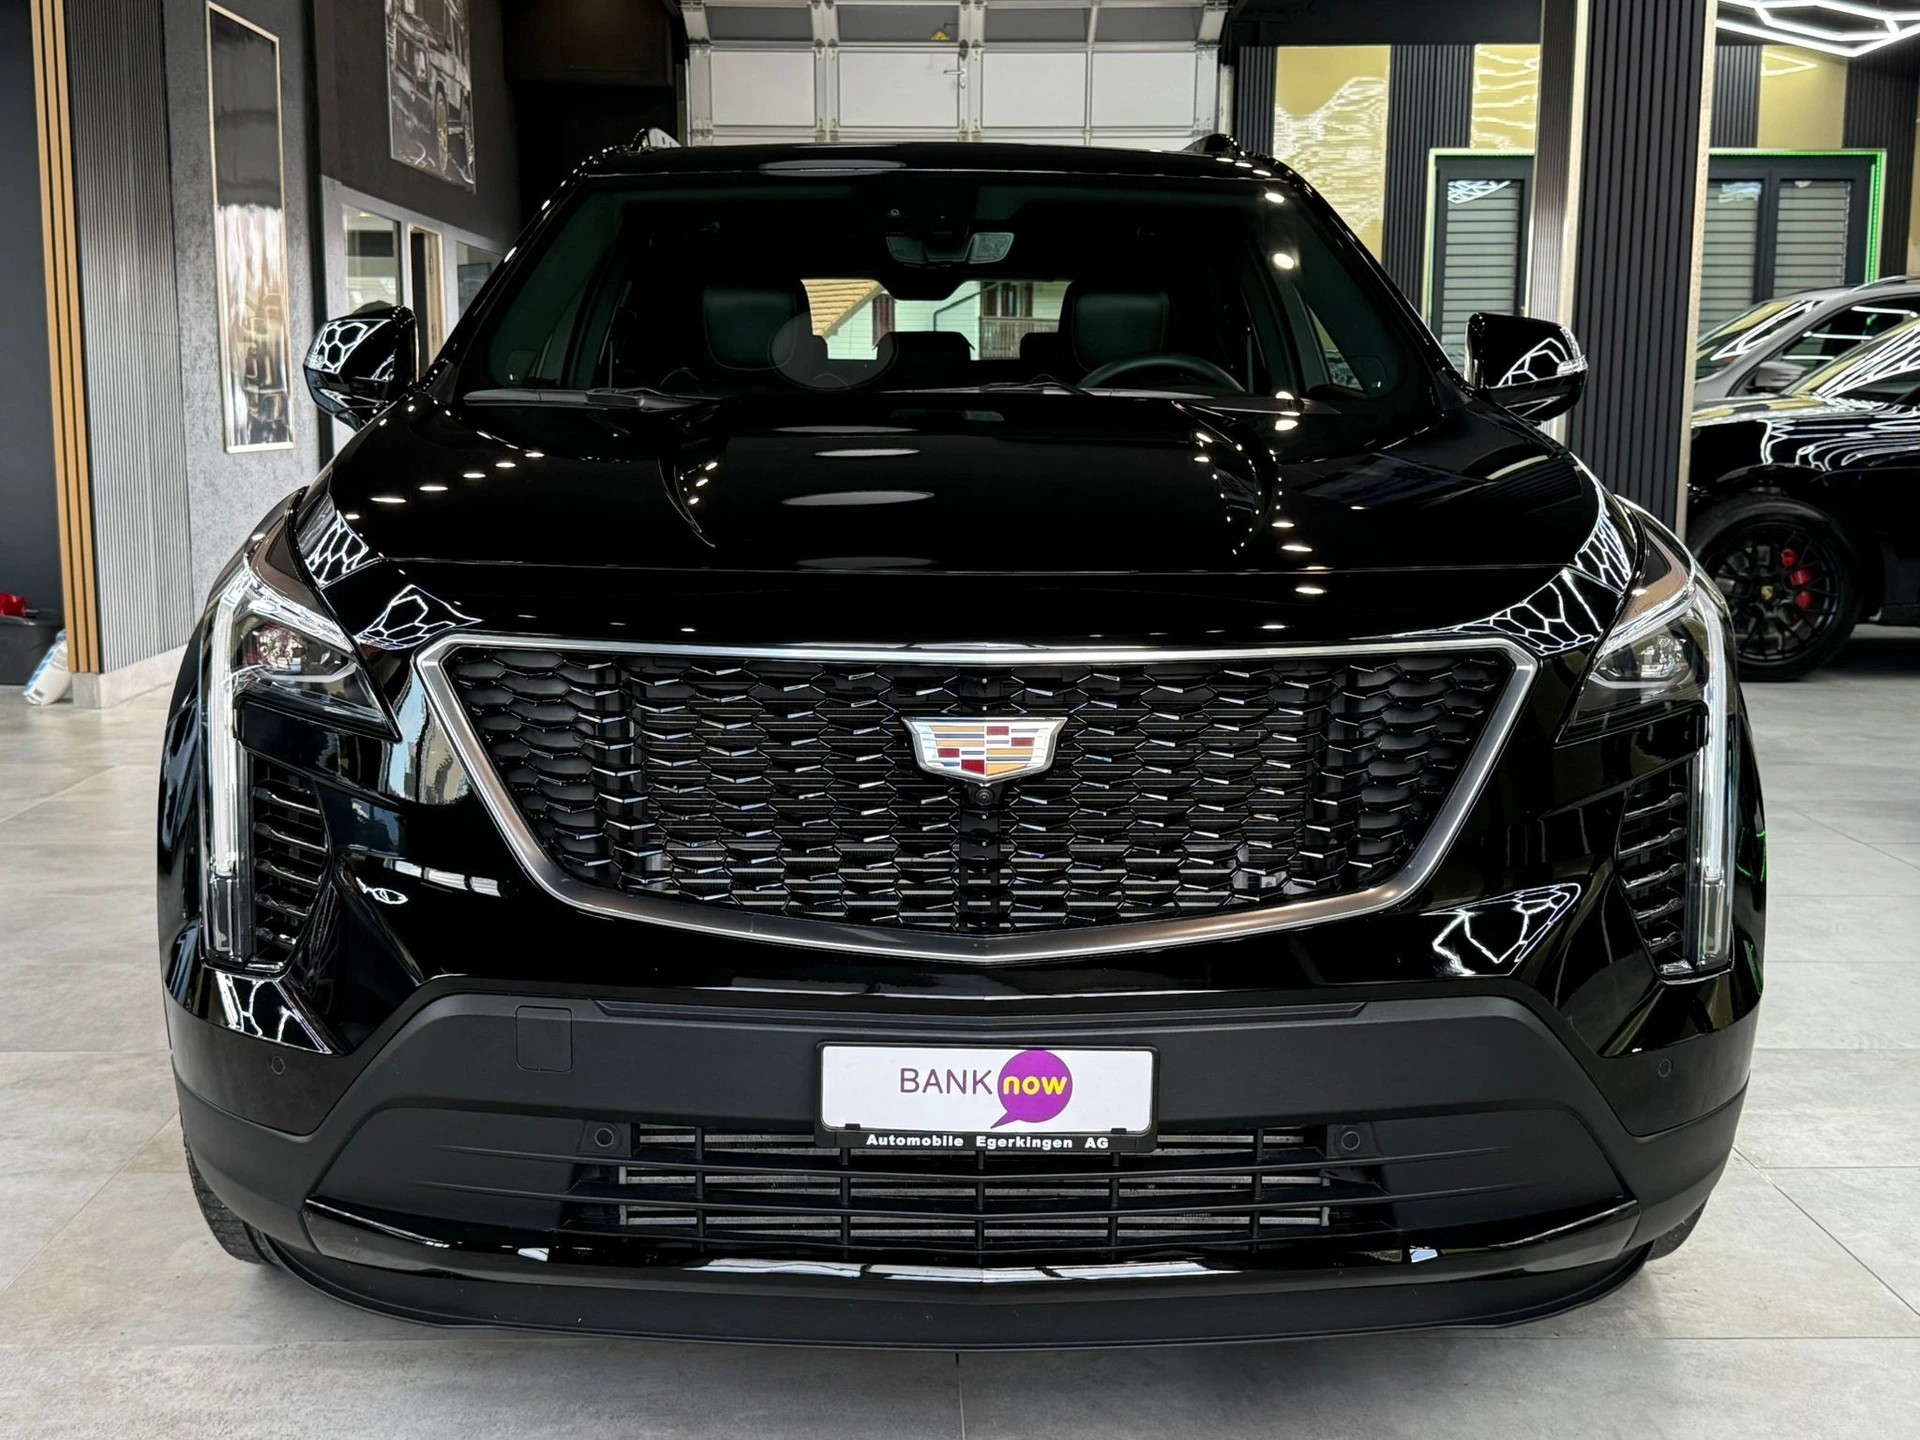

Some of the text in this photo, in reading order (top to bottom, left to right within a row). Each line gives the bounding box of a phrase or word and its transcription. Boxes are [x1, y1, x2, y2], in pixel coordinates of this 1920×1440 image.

[900, 1067, 1067, 1096] BANK now
[866, 1134, 1109, 1151] Automobile Egerkingen AG
